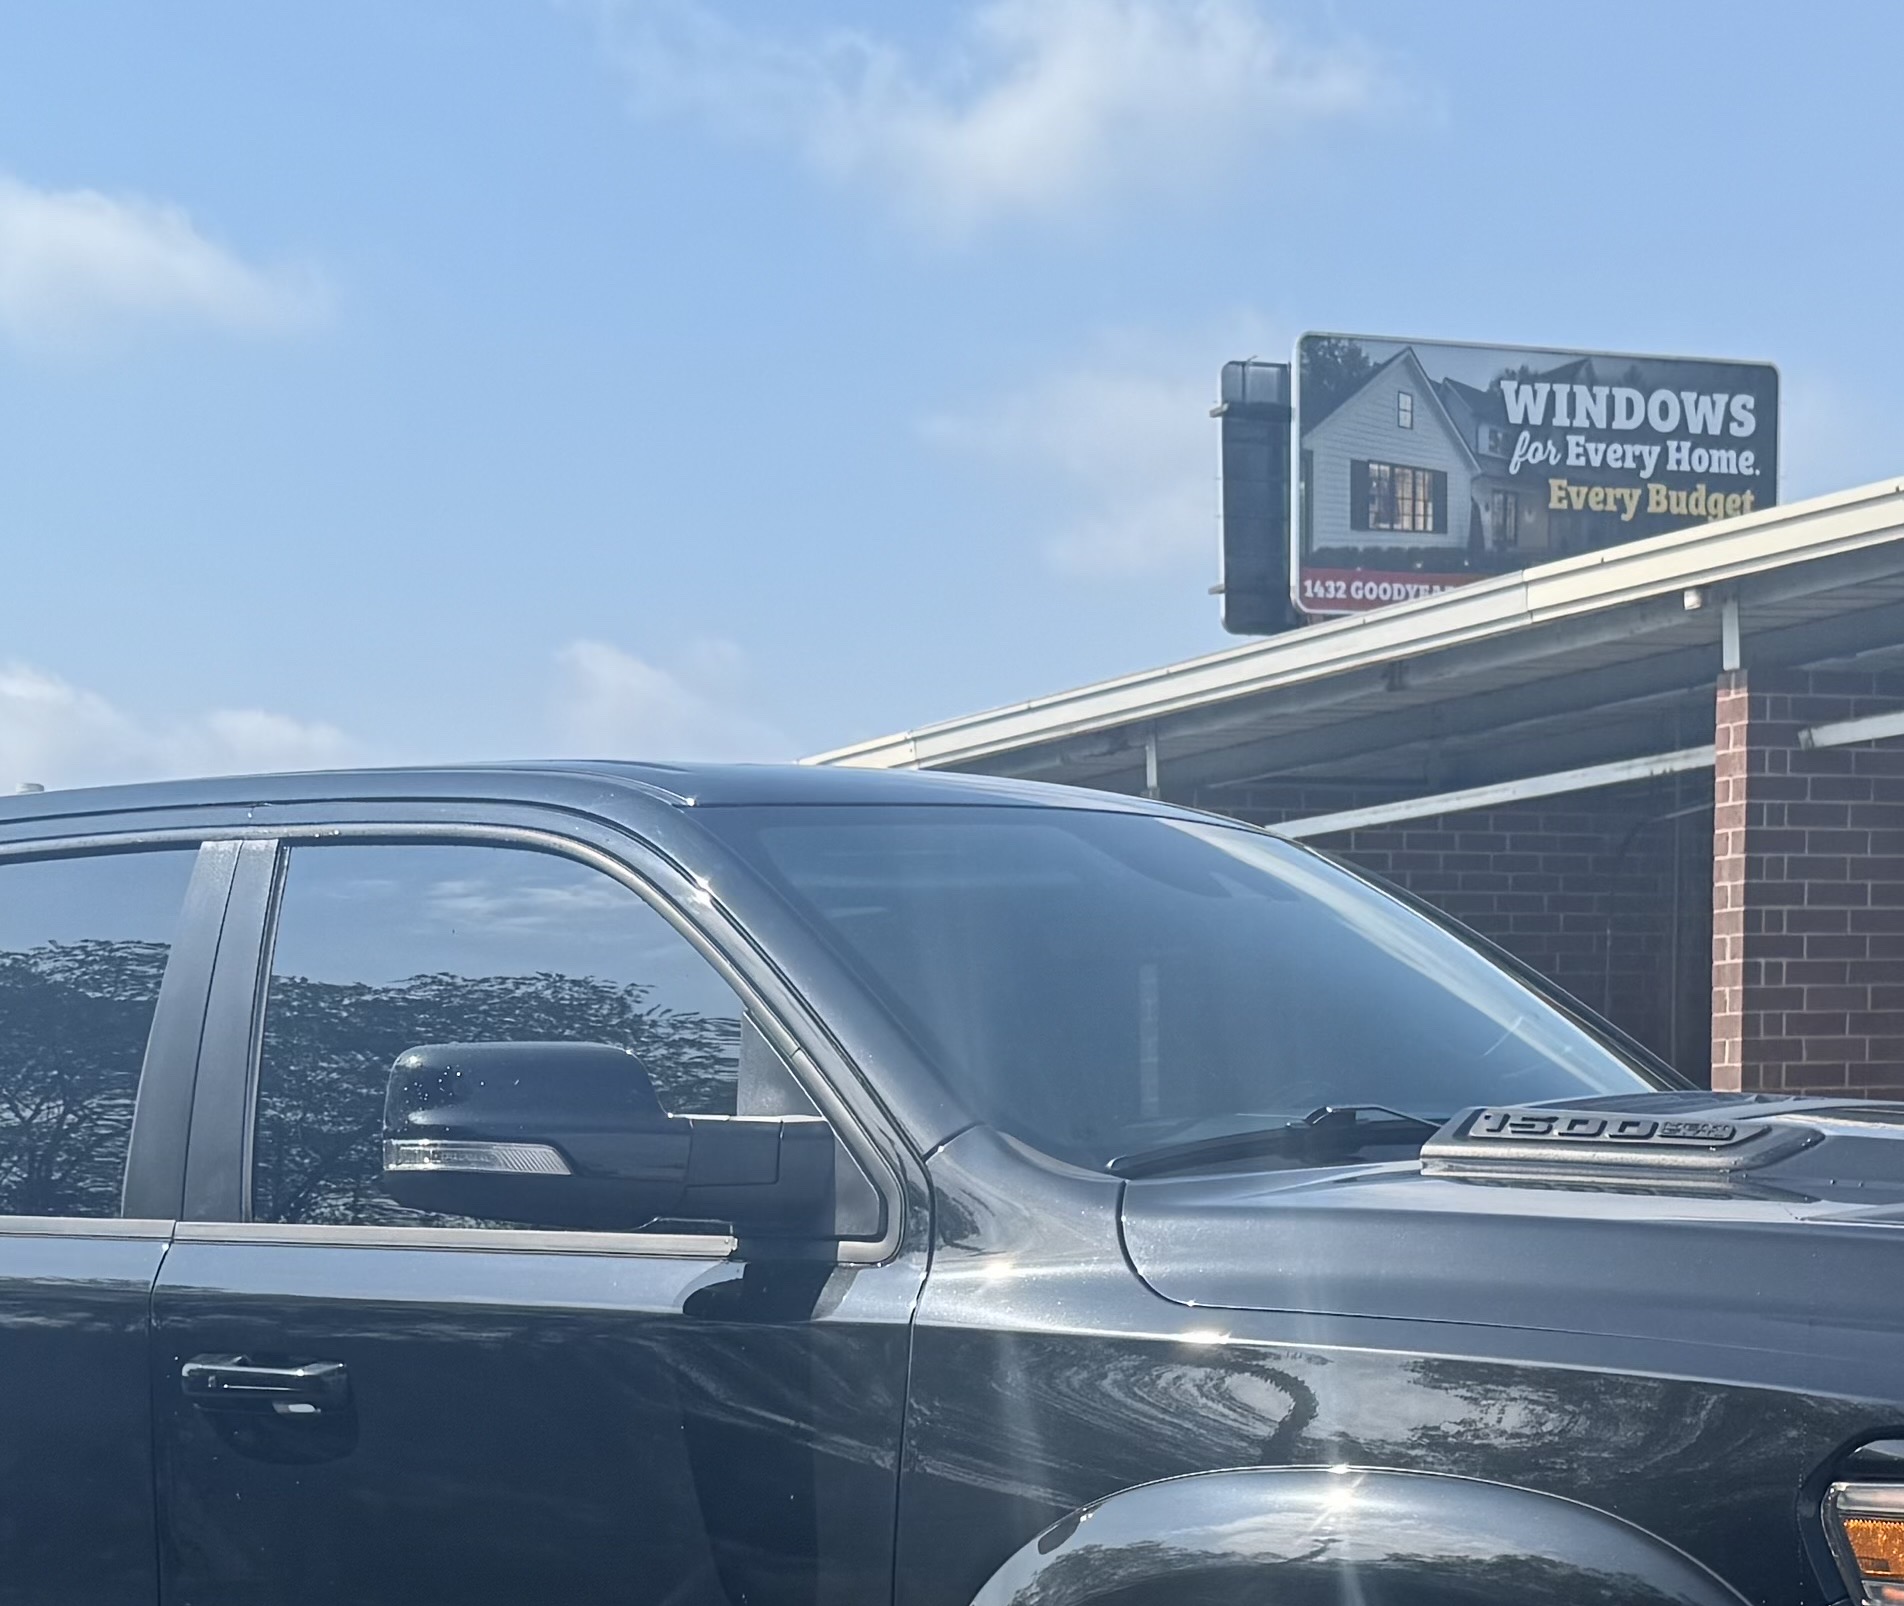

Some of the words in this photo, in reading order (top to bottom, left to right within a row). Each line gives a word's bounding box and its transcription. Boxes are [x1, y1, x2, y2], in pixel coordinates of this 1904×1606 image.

[1500, 380, 1756, 437] WINDOWS
[1508, 430, 1562, 475] for
[1566, 435, 1661, 479] Every
[1666, 440, 1761, 476] Home.
[1548, 478, 1642, 522] Every
[1647, 483, 1755, 523] Budget
[1304, 579, 1347, 599] 1432
[1350, 581, 1454, 600] GOODYE
[1482, 1112, 1659, 1140] 1500
